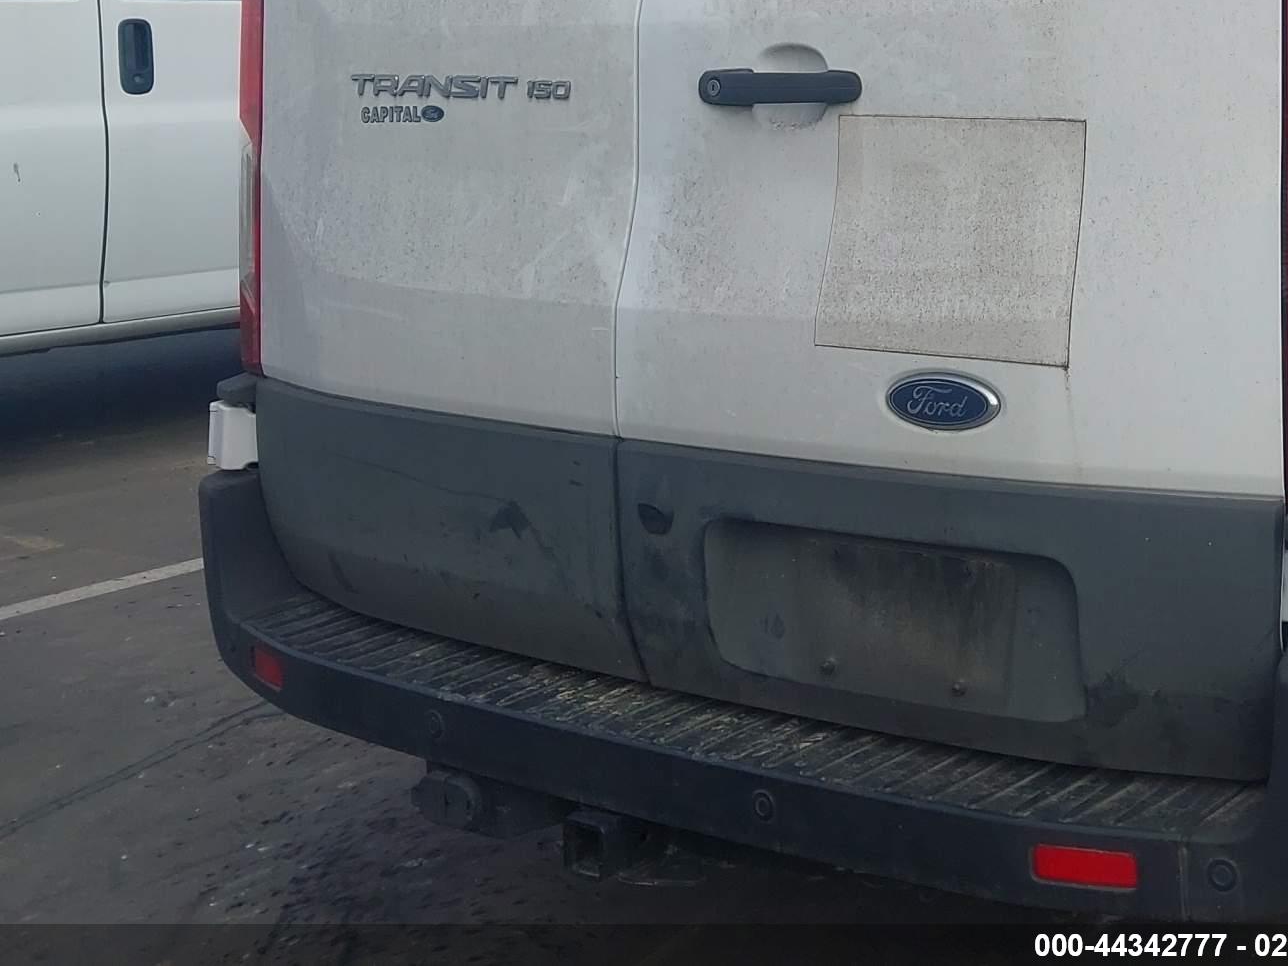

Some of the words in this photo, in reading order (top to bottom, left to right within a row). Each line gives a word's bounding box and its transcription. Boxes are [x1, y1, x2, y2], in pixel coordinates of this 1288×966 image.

[351, 74, 518, 99] TRANSIT
[526, 80, 571, 99] 150
[361, 105, 421, 123] CAPITAL
[907, 385, 968, 417] Ford
